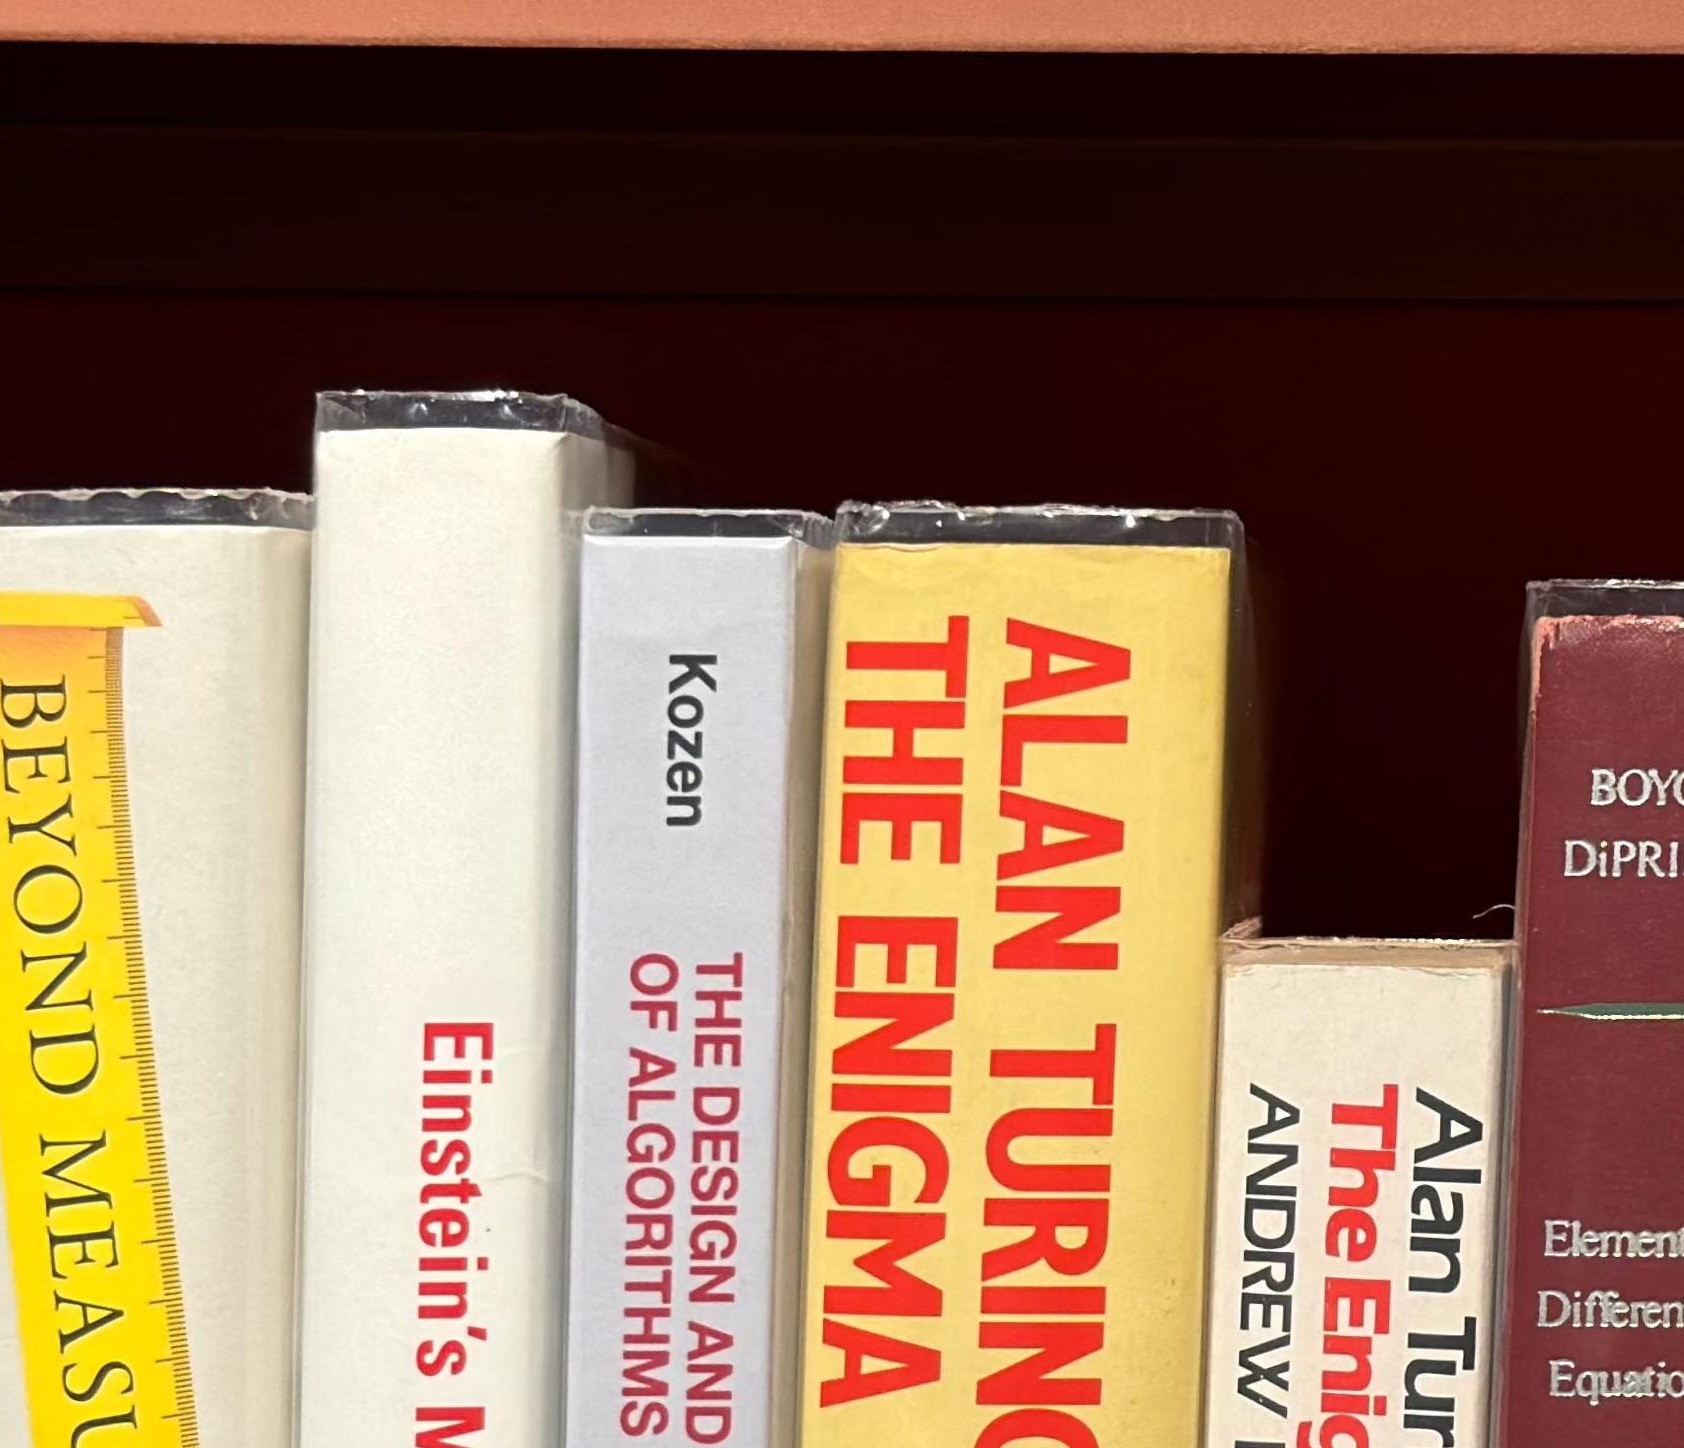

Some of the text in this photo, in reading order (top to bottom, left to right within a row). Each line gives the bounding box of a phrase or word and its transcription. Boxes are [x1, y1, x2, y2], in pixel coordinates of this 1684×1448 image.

[666, 655, 717, 826] Kozen
[993, 618, 1131, 970] ALAN
[0, 675, 102, 1094] BEYOND
[694, 952, 743, 1067] THE
[820, 616, 969, 1409] THE ENIGMA
[620, 954, 679, 1436] OF ALGORITHMS
[689, 1087, 740, 1301] DESIGN
[1238, 1083, 1300, 1418] ANDREW
[1325, 1084, 1399, 1262] The
[1409, 1087, 1483, 1293] Alan
[686, 1321, 733, 1444] AND
